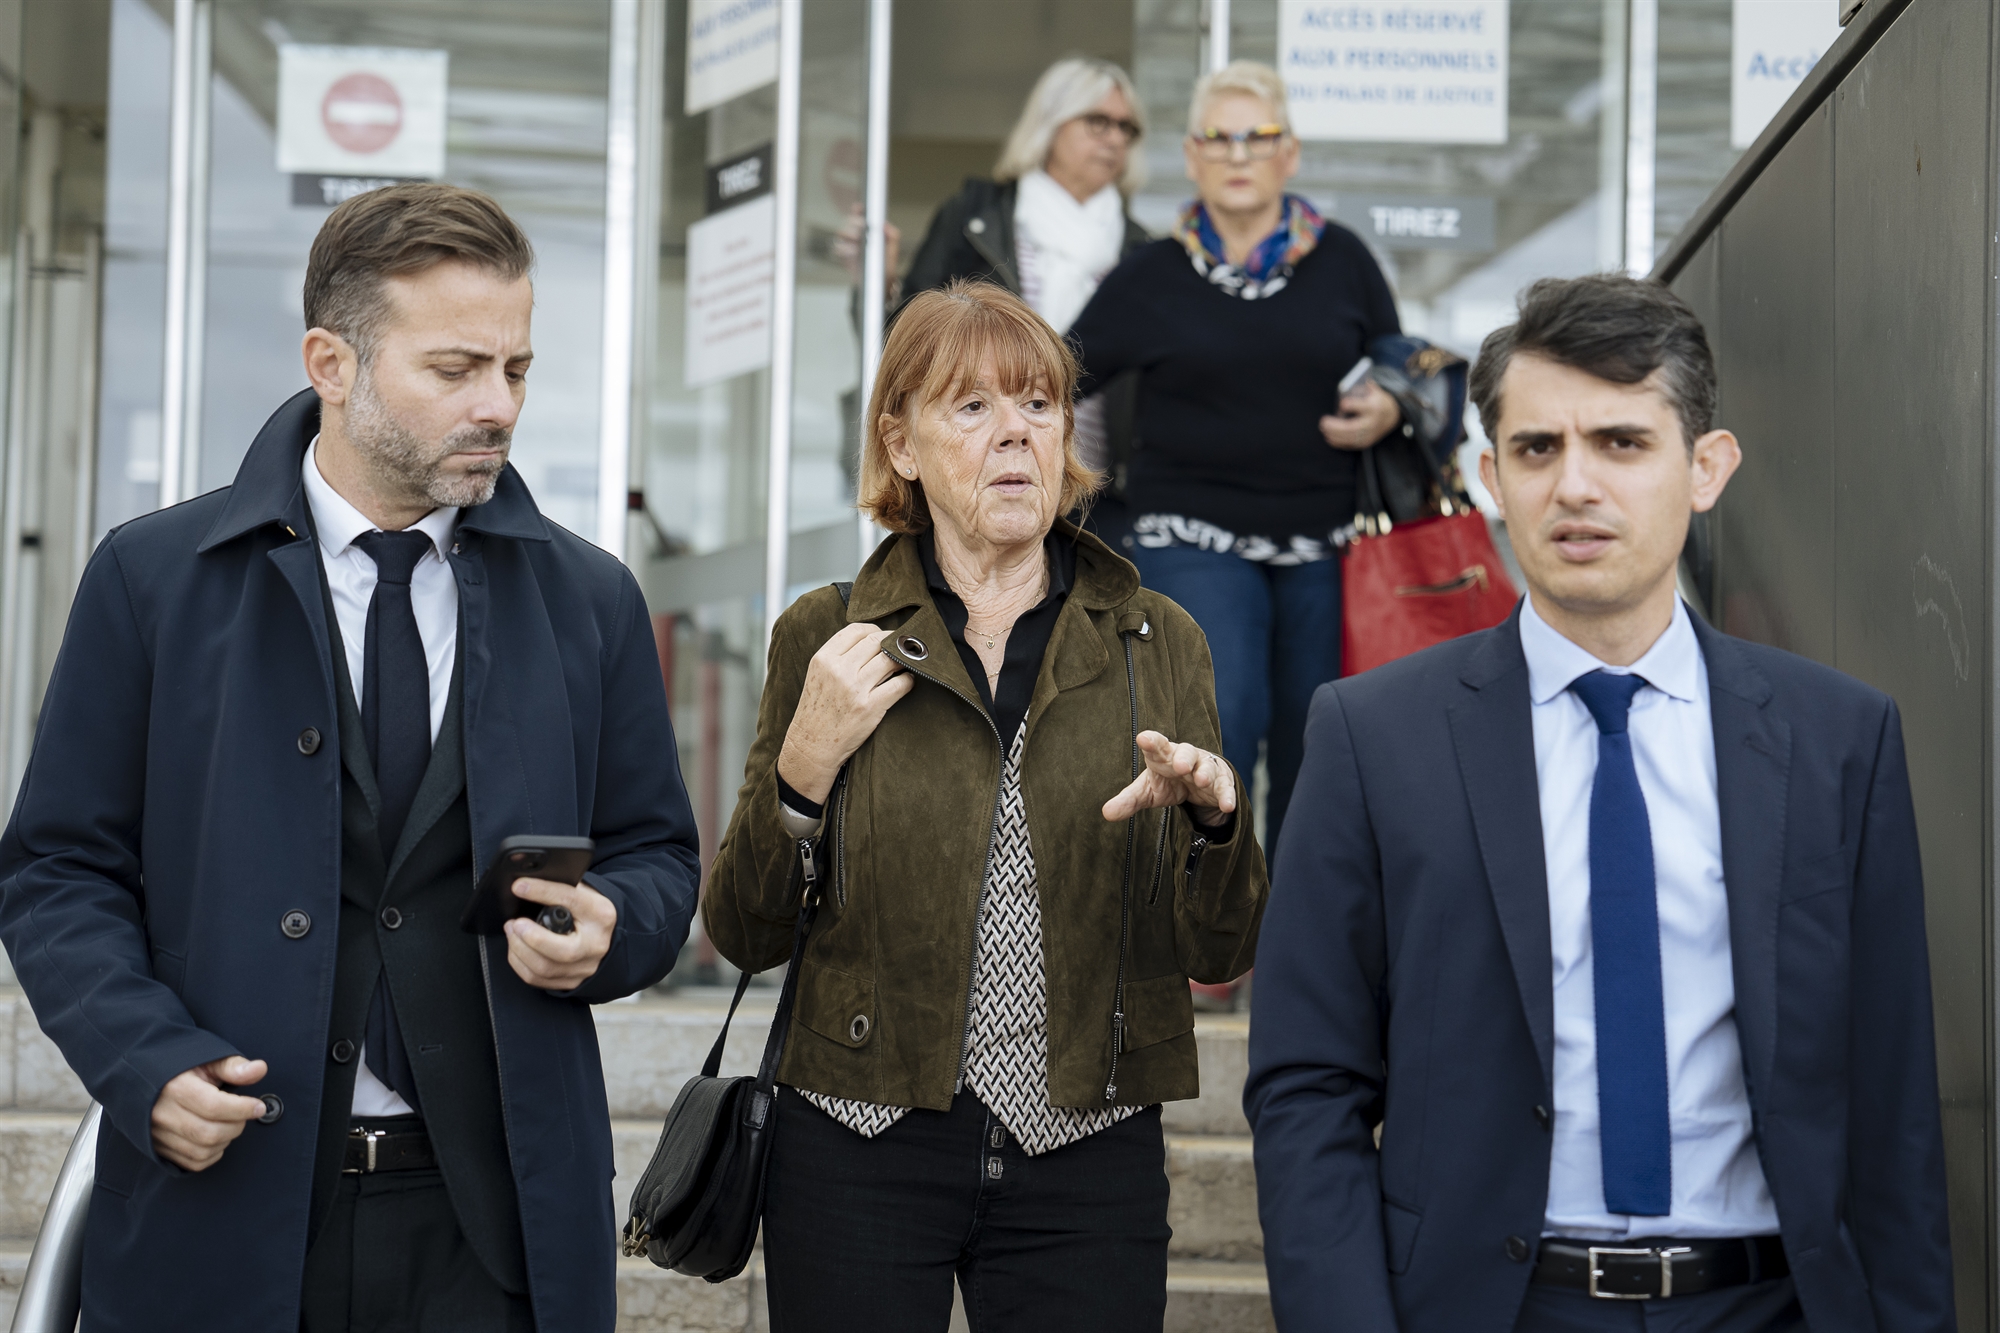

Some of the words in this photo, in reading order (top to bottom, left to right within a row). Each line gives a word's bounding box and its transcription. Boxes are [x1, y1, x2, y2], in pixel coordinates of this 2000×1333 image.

[1302, 5, 1375, 31] ACCÈS
[1383, 4, 1485, 33] RÉSERVÉ
[1290, 47, 1336, 69] AUX
[1345, 48, 1496, 71] PERSONNELS
[1391, 85, 1416, 104] DE
[1371, 207, 1461, 237] TIREZ
